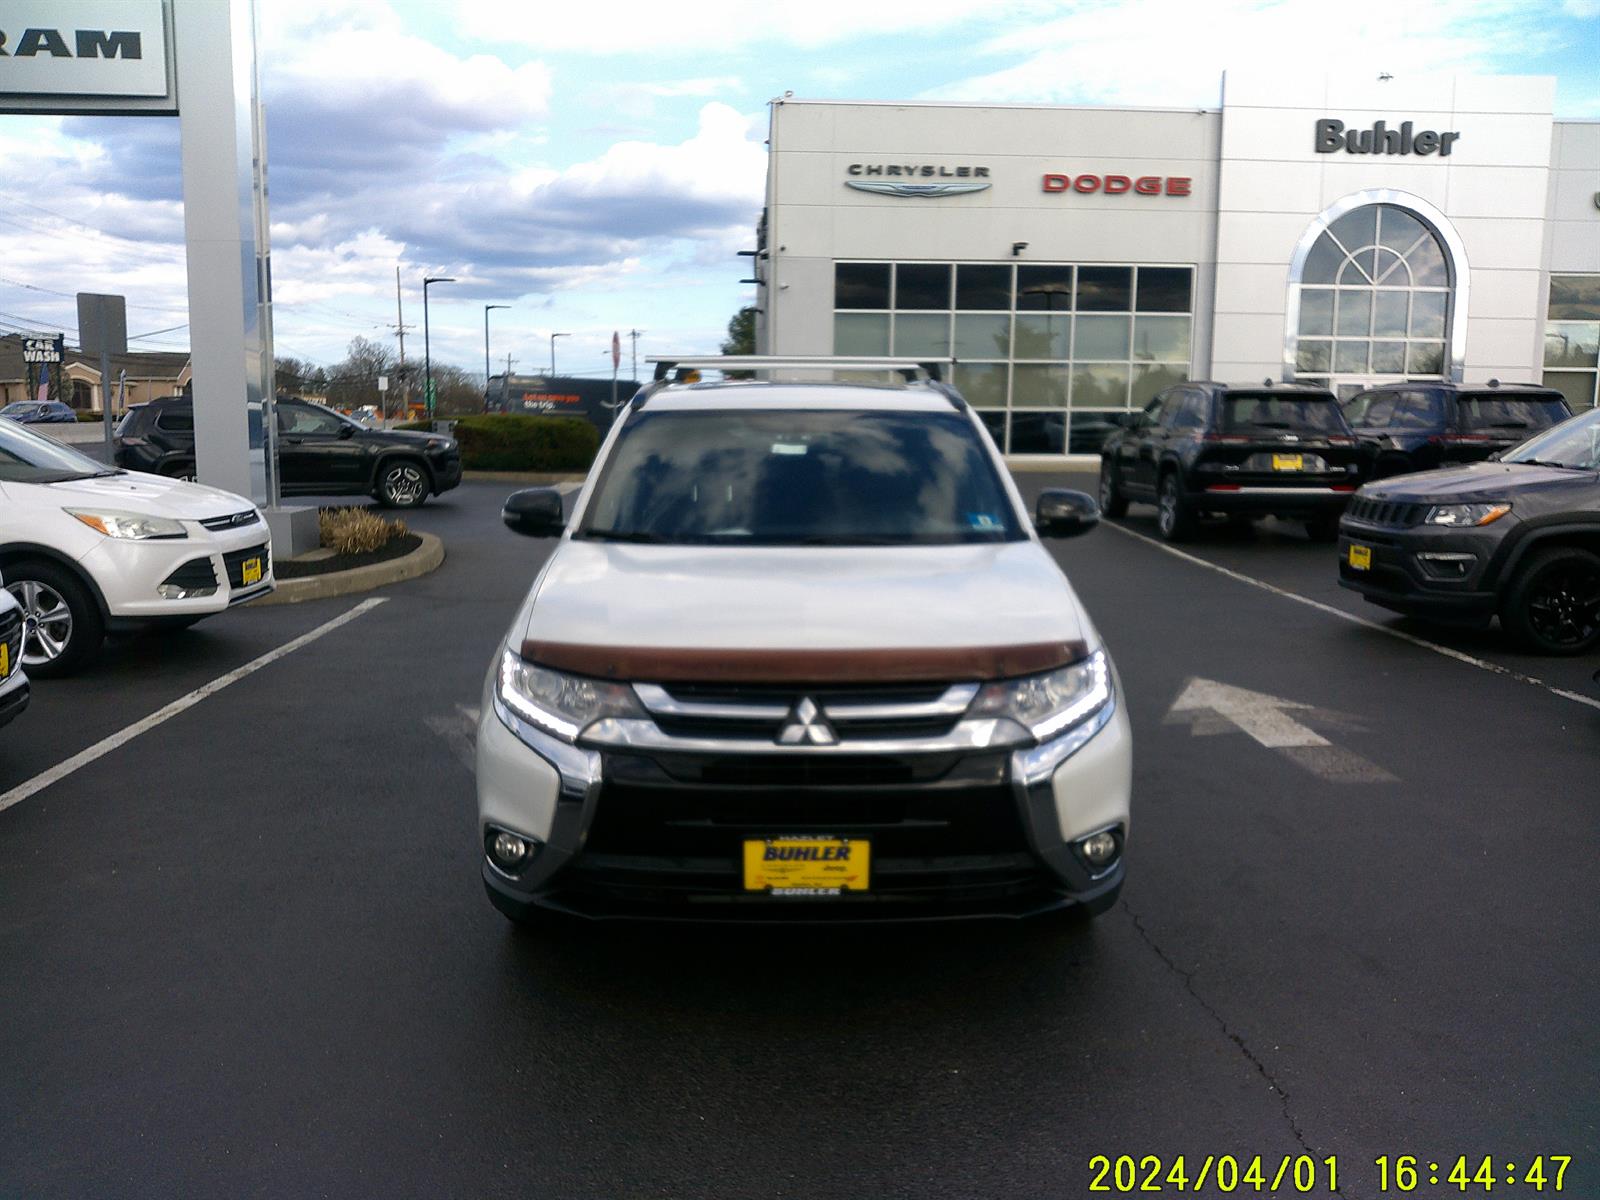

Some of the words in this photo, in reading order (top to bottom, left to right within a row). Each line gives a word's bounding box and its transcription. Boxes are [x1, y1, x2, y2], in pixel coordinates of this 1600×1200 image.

[0, 28, 142, 59] AM
[1315, 119, 1460, 156] Buhler
[848, 163, 991, 178] CHRYSLER
[1042, 172, 1192, 196] DODGE
[26, 339, 55, 350] CAR
[24, 350, 60, 362] WASH
[764, 846, 850, 861] BUHLER
[770, 887, 840, 896] BUHLER
